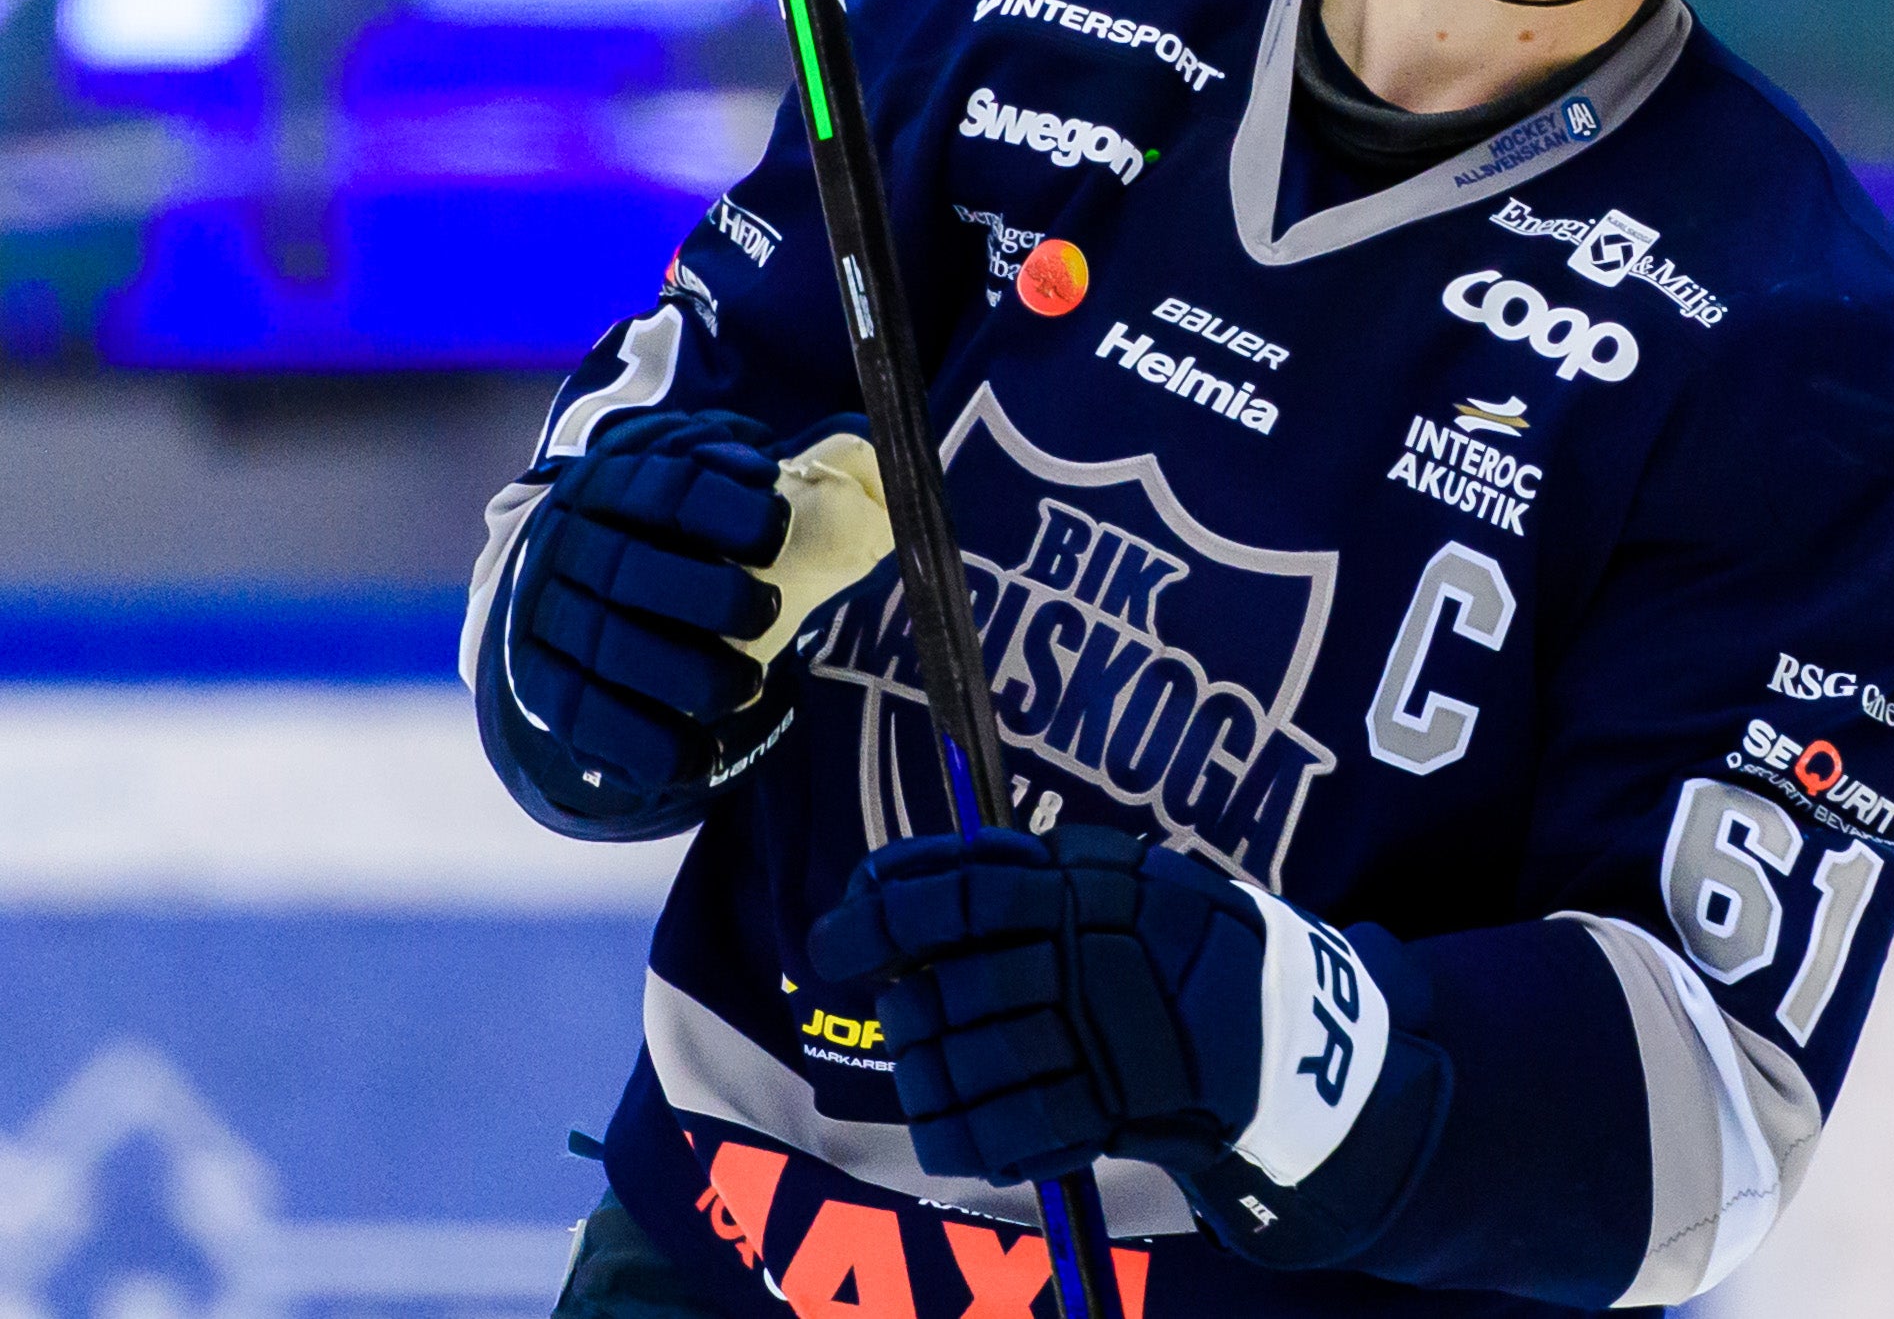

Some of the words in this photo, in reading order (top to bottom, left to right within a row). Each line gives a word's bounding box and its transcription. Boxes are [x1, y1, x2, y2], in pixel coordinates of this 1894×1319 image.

[959, 87, 1144, 186] Swegon
[1454, 130, 1570, 188] ALLSVENSKAN
[1488, 113, 1556, 157] HOCKEY
[1490, 196, 1597, 244] Energi
[1096, 322, 1280, 436] Helmia
[1386, 451, 1530, 537] AKUSTIK
[1404, 415, 1544, 500] INTEROC
[1024, 498, 1190, 636] BIK
[1365, 540, 1517, 777] C
[1767, 652, 1858, 701] RSG
[1660, 778, 1884, 1049] 61
